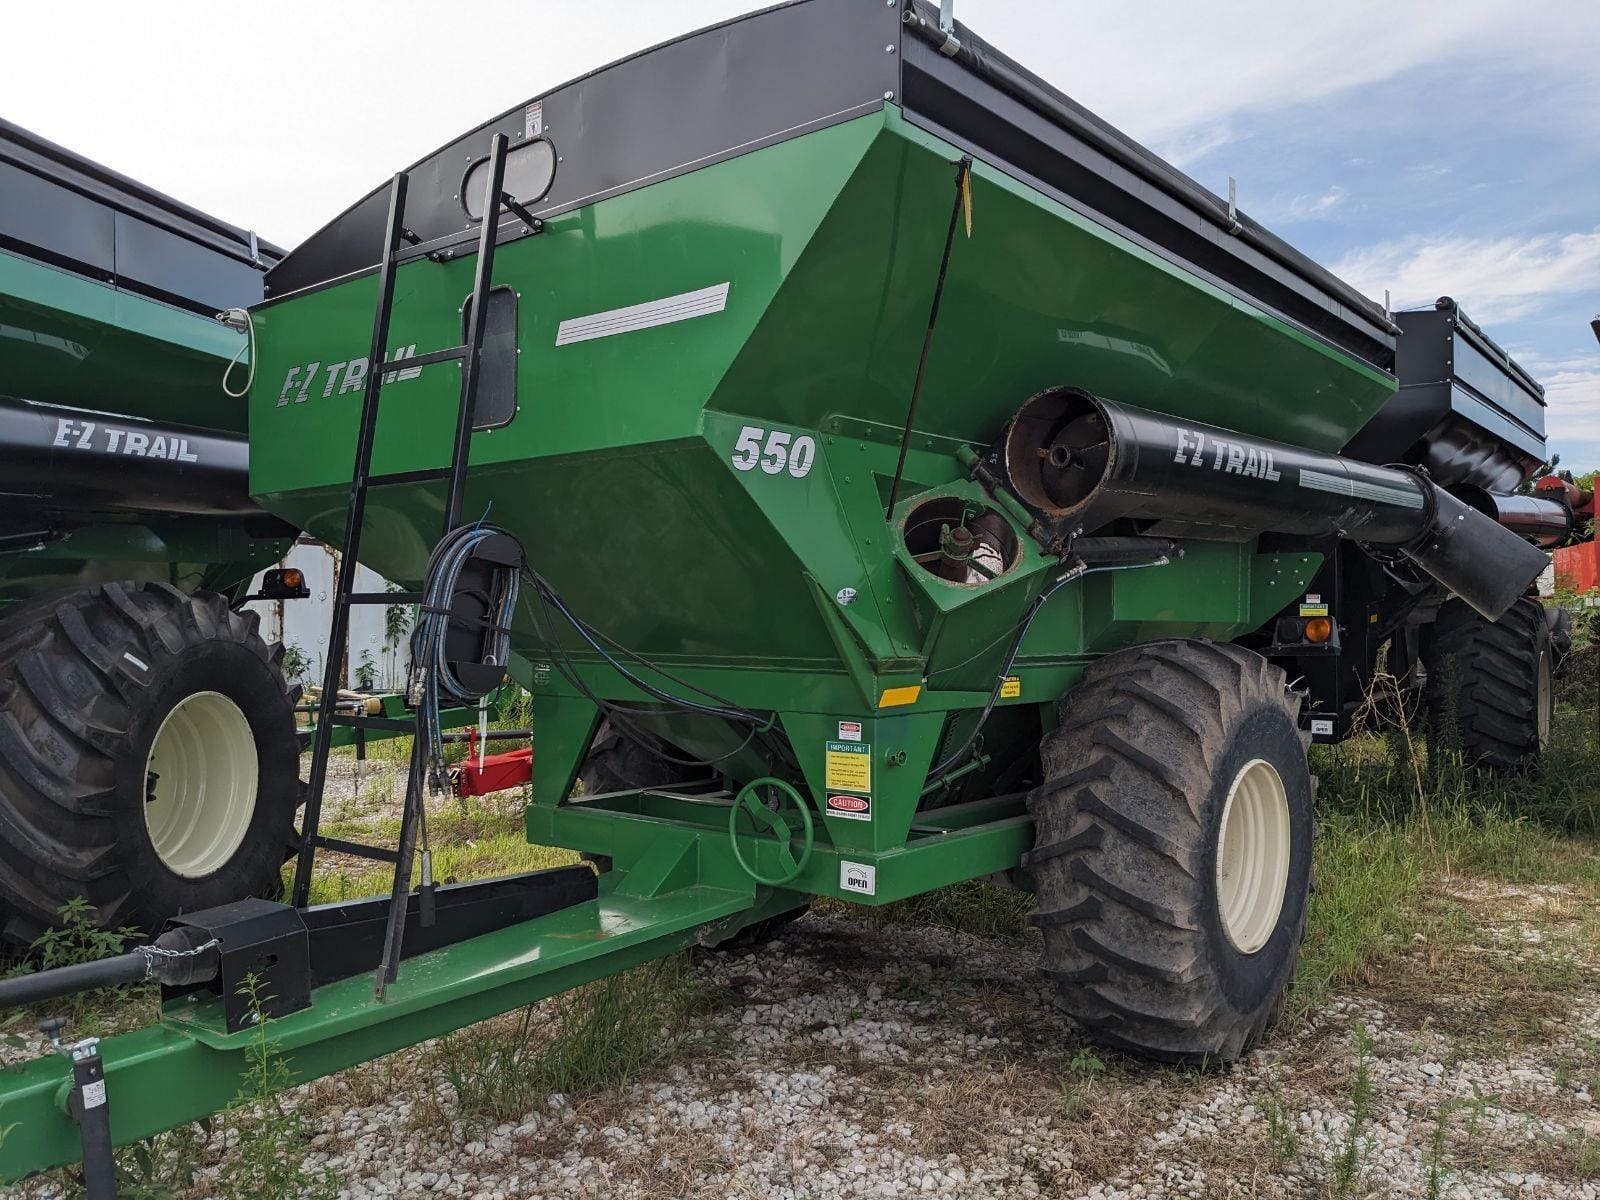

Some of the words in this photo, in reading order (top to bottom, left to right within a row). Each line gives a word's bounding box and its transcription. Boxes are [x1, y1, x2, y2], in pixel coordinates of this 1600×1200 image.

[276, 361, 321, 408] E-Z
[52, 418, 95, 450] E-Z
[105, 428, 198, 463] TRAIL
[731, 425, 816, 478] 550
[1173, 427, 1205, 466] E-Z
[1212, 439, 1281, 482] TRAIL
[830, 743, 866, 753] IMPORTANT
[833, 798, 863, 809] CAUTION
[847, 876, 868, 889] OPEN
